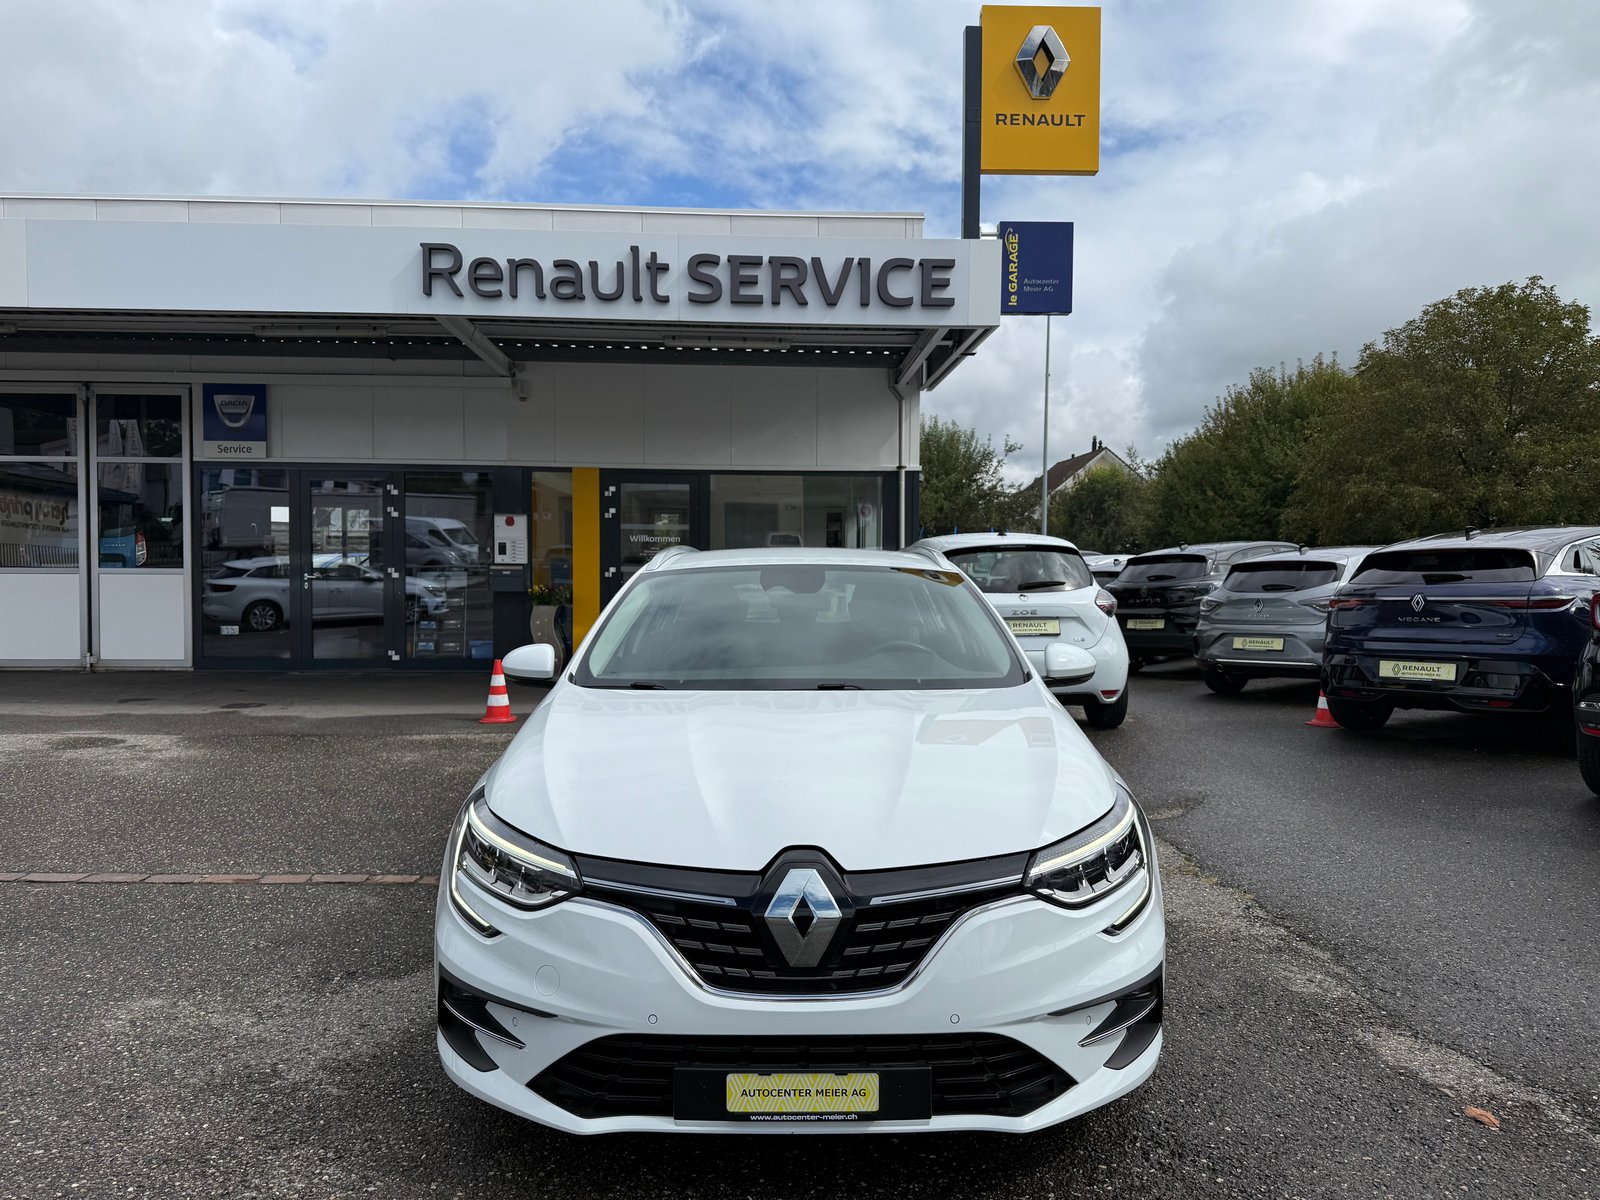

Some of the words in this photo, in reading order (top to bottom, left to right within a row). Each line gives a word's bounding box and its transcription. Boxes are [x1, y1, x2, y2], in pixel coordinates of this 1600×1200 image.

[995, 113, 1086, 126] RENAULT
[1008, 233, 1019, 293] GARAGE
[420, 242, 669, 304] Renault
[685, 253, 954, 308] SERVICE
[1008, 295, 1018, 306] le
[217, 444, 252, 454] Service
[629, 534, 681, 543] Willkommen
[1402, 665, 1442, 673] RENAULT
[740, 1087, 813, 1098] AUTOCENTER
[815, 1087, 848, 1098] MEIER
[851, 1087, 867, 1098] AG
[750, 1113, 858, 1121] www.autocenter-meier.ch
